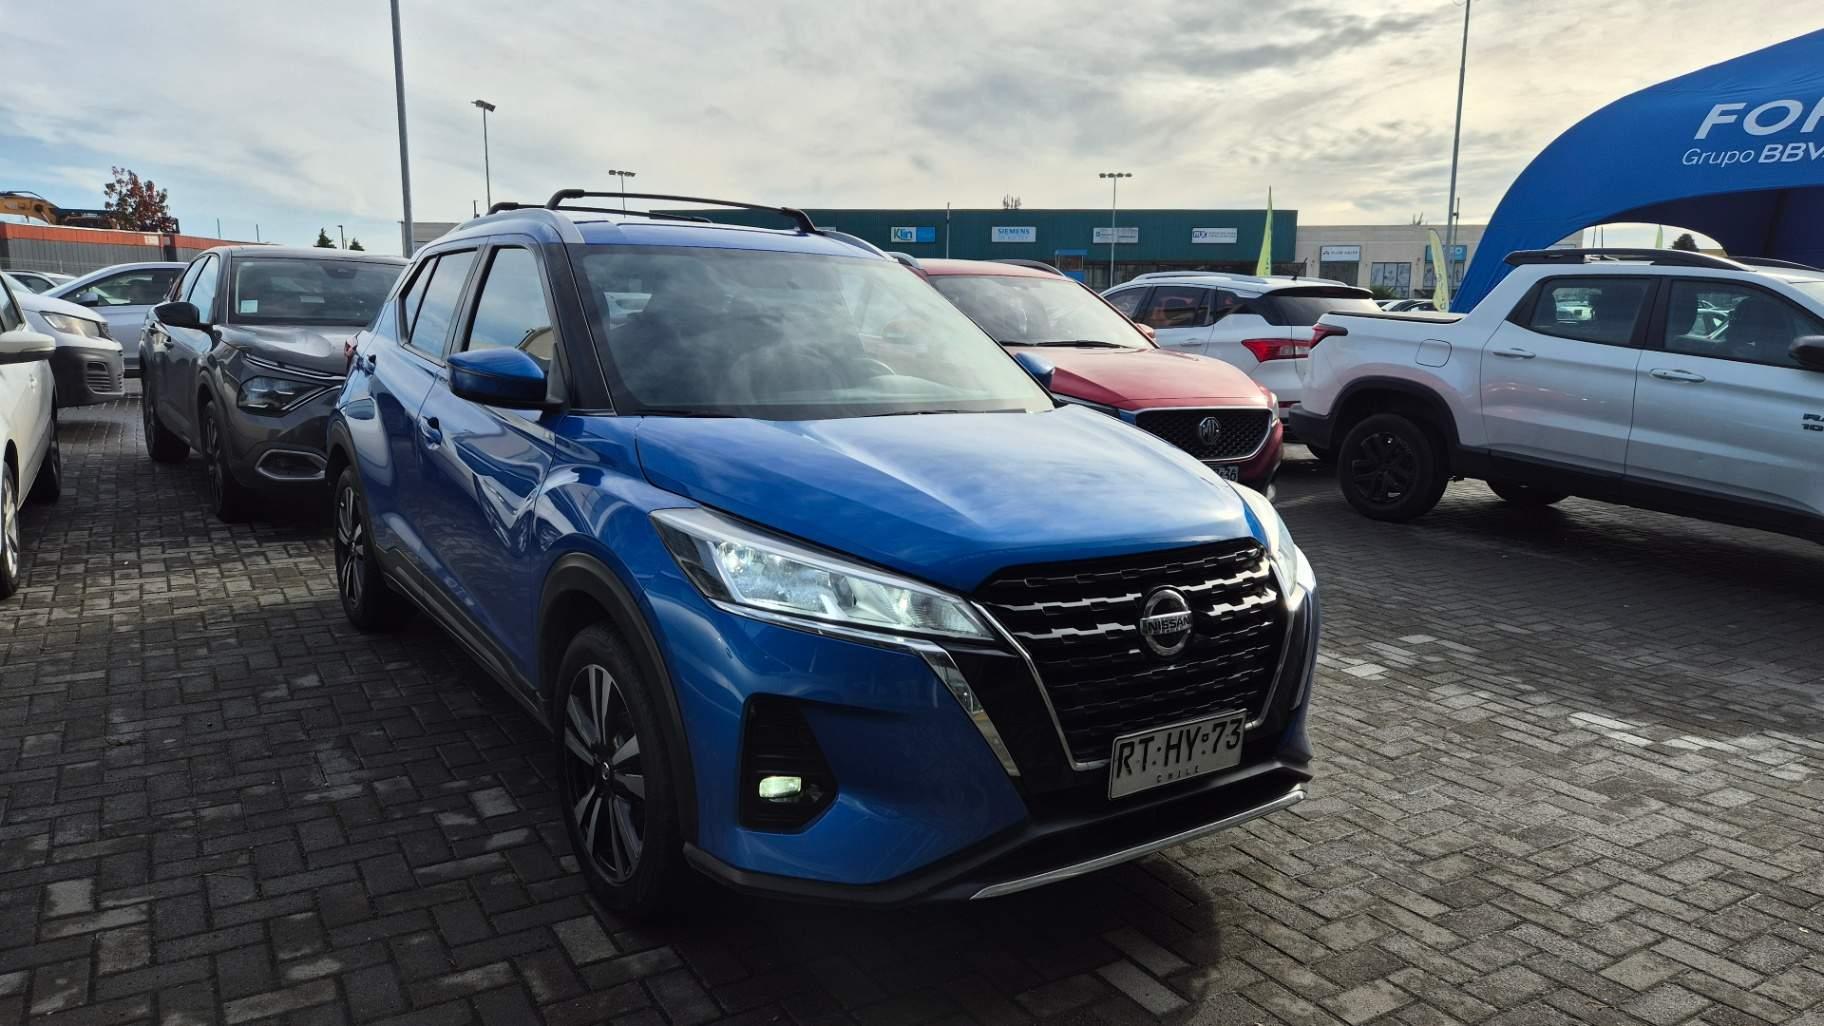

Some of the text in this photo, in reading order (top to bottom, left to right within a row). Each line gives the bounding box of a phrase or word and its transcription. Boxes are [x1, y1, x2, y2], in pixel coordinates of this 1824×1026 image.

[1682, 142, 1824, 168] Grupo BBV
[893, 227, 913, 240] Klin
[997, 227, 1030, 235] SIEMENS
[1149, 615, 1190, 634] NISSAN
[1156, 764, 1200, 783] CHILE
